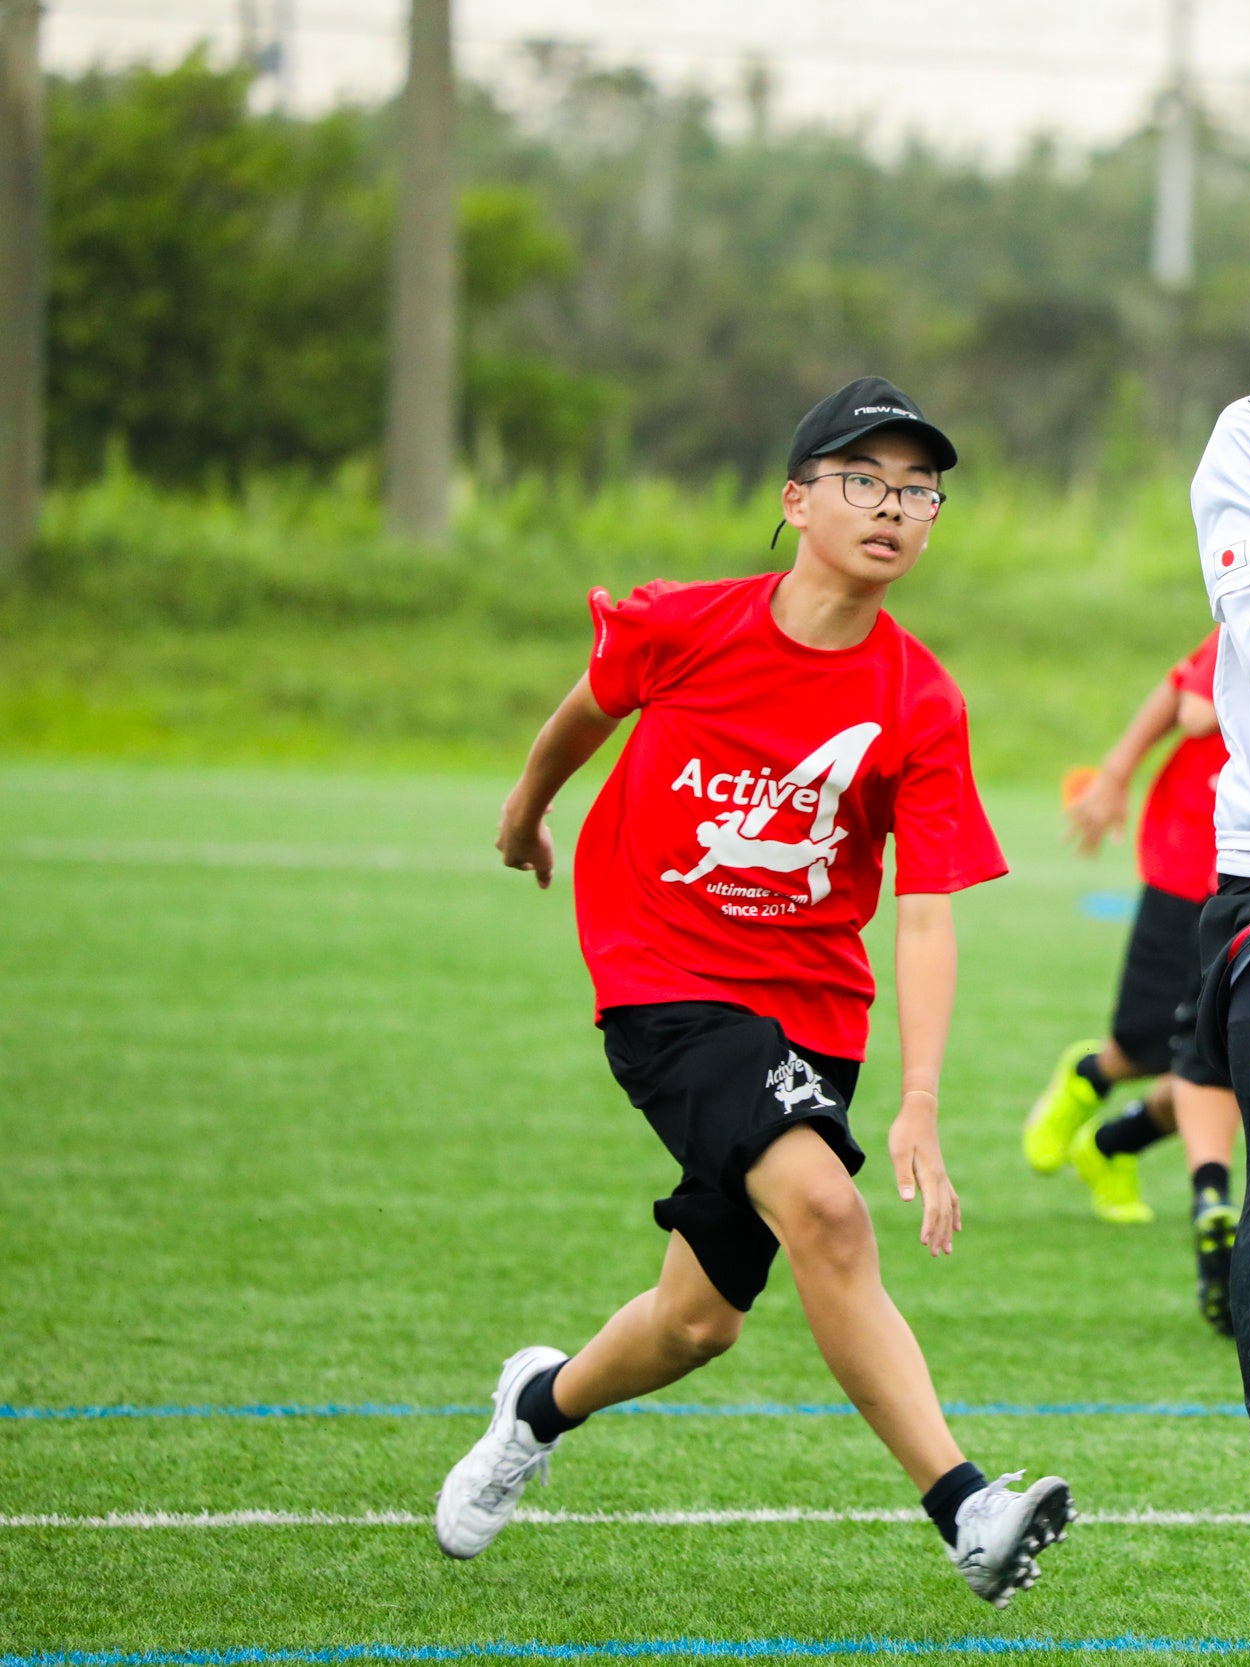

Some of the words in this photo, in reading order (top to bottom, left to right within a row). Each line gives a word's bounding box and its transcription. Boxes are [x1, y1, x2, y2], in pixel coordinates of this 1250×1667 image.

[854, 406, 890, 416] new
[671, 757, 819, 813] Active
[706, 881, 771, 898] ultimate
[721, 902, 758, 917] since
[761, 902, 797, 917] 2014
[765, 1059, 805, 1088] Active
